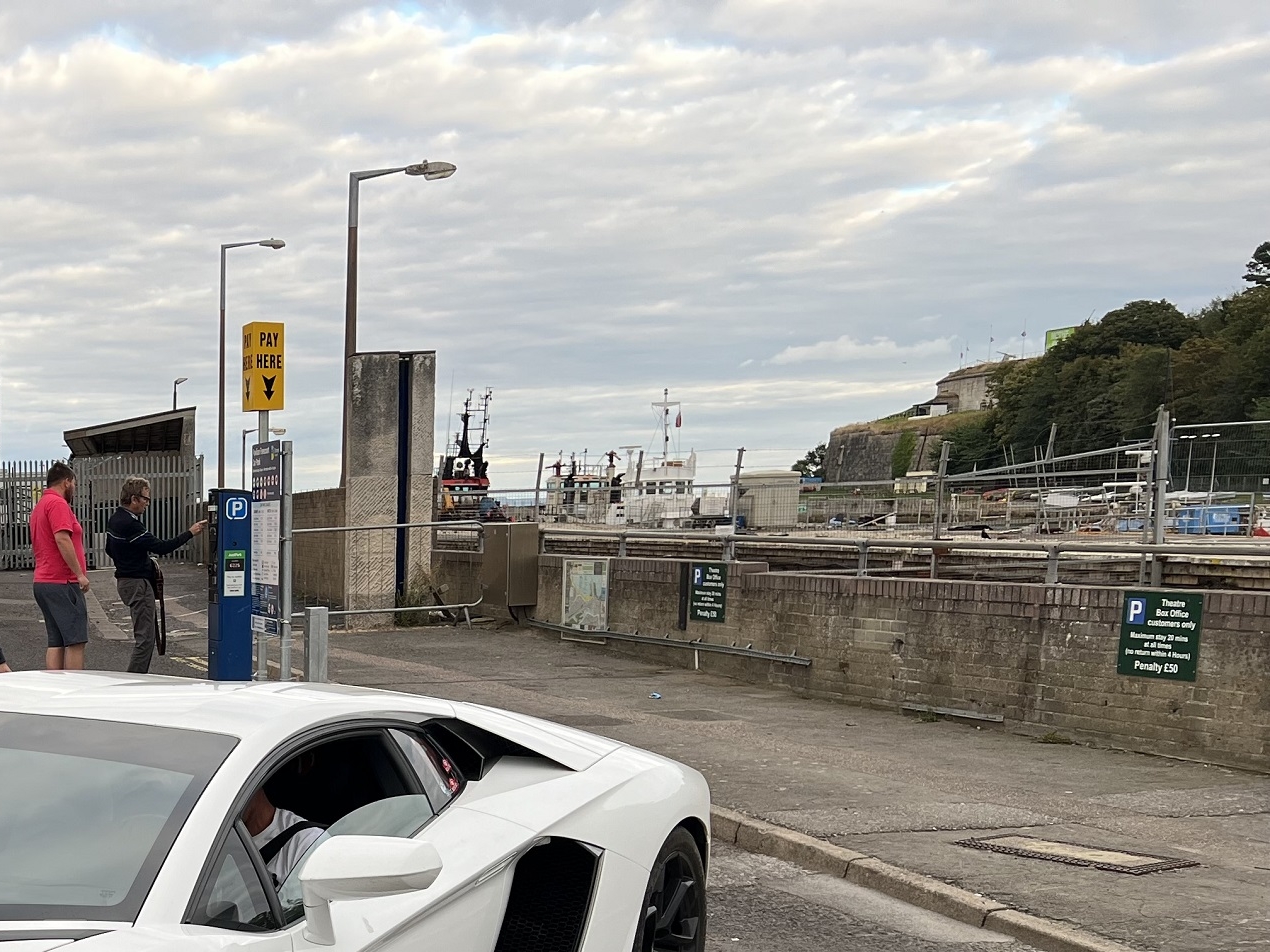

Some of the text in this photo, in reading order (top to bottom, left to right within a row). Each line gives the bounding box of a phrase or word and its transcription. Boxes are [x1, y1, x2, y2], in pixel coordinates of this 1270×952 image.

[260, 332, 279, 347] PAY
[256, 354, 282, 369] HERE
[232, 502, 243, 516] P
[694, 568, 701, 584] P
[1129, 600, 1143, 621] P
[1162, 599, 1186, 608] Theatre
[1156, 609, 1189, 618] Box Office
[1147, 620, 1196, 630] customers only
[1130, 632, 1155, 640] Maximum
[1155, 634, 1167, 642] stay
[1134, 660, 1178, 674] Penalty £50
